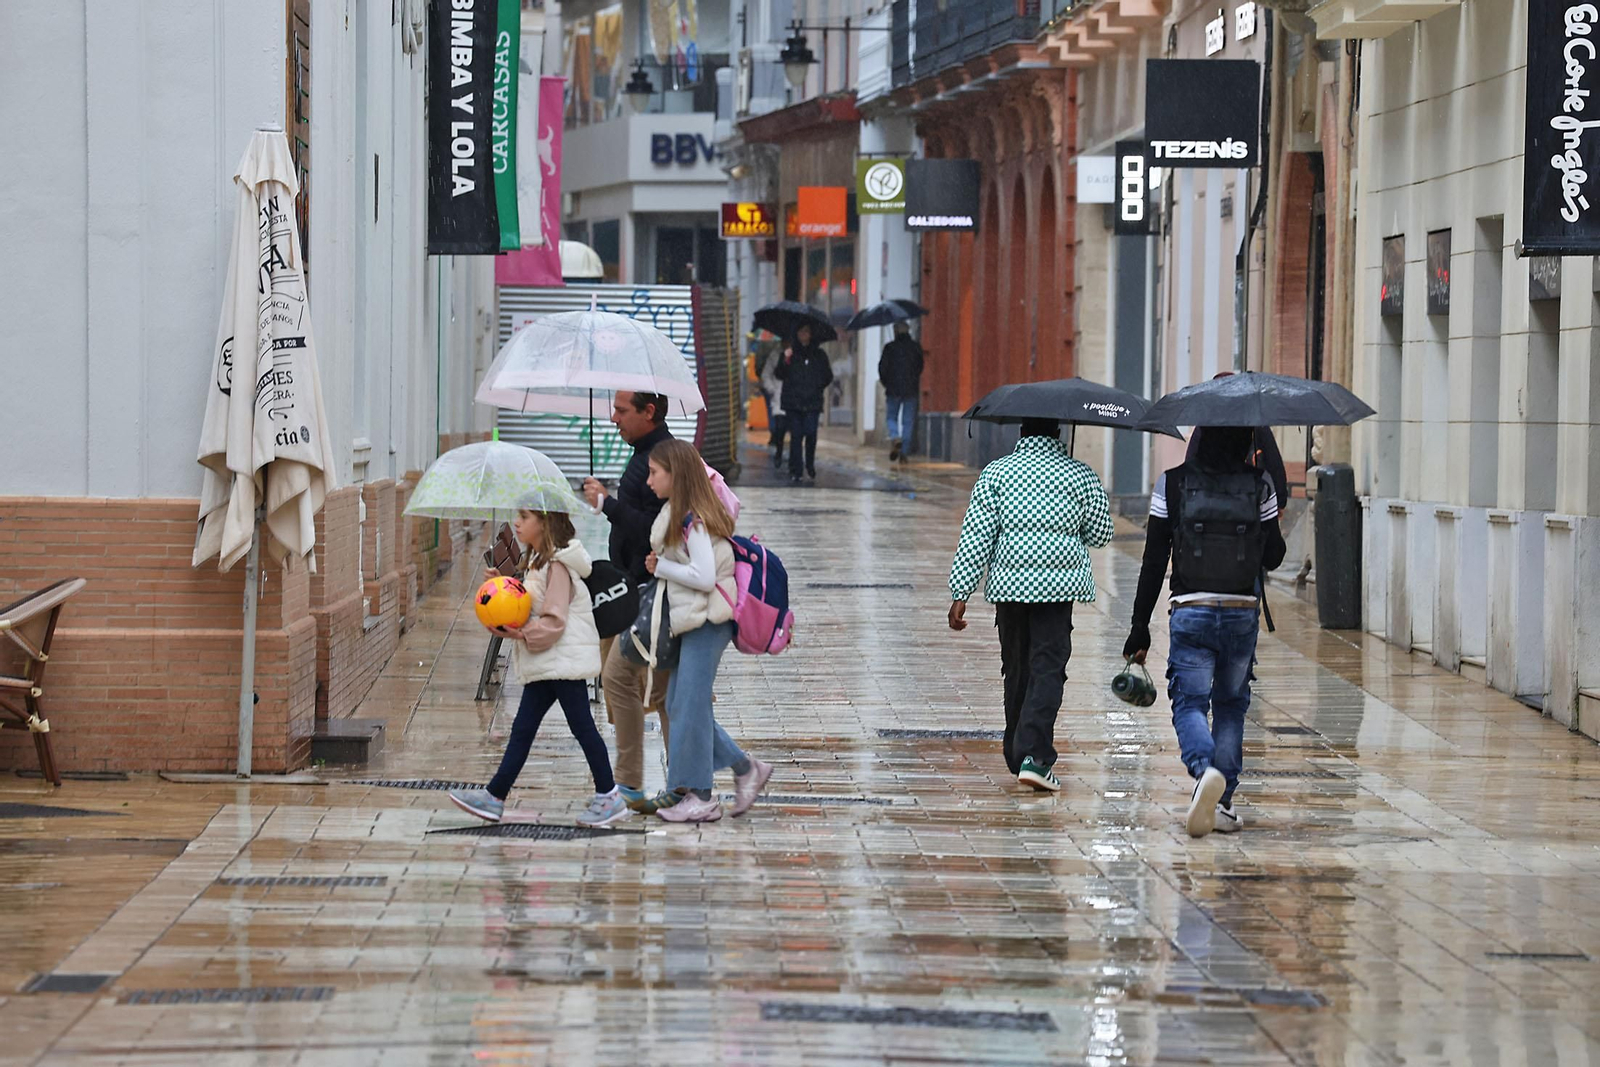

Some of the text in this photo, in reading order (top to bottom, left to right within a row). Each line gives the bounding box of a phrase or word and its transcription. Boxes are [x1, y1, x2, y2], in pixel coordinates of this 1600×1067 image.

[1564, 3, 1599, 38] El
[1562, 38, 1597, 113] Corte
[450, 0, 476, 197] BIMBA Y LOLA
[492, 31, 511, 174] CARCASAS
[651, 133, 724, 165] BBV
[799, 223, 842, 236] orange
[1098, 409, 1118, 418] MIND
[592, 582, 629, 609] AD
